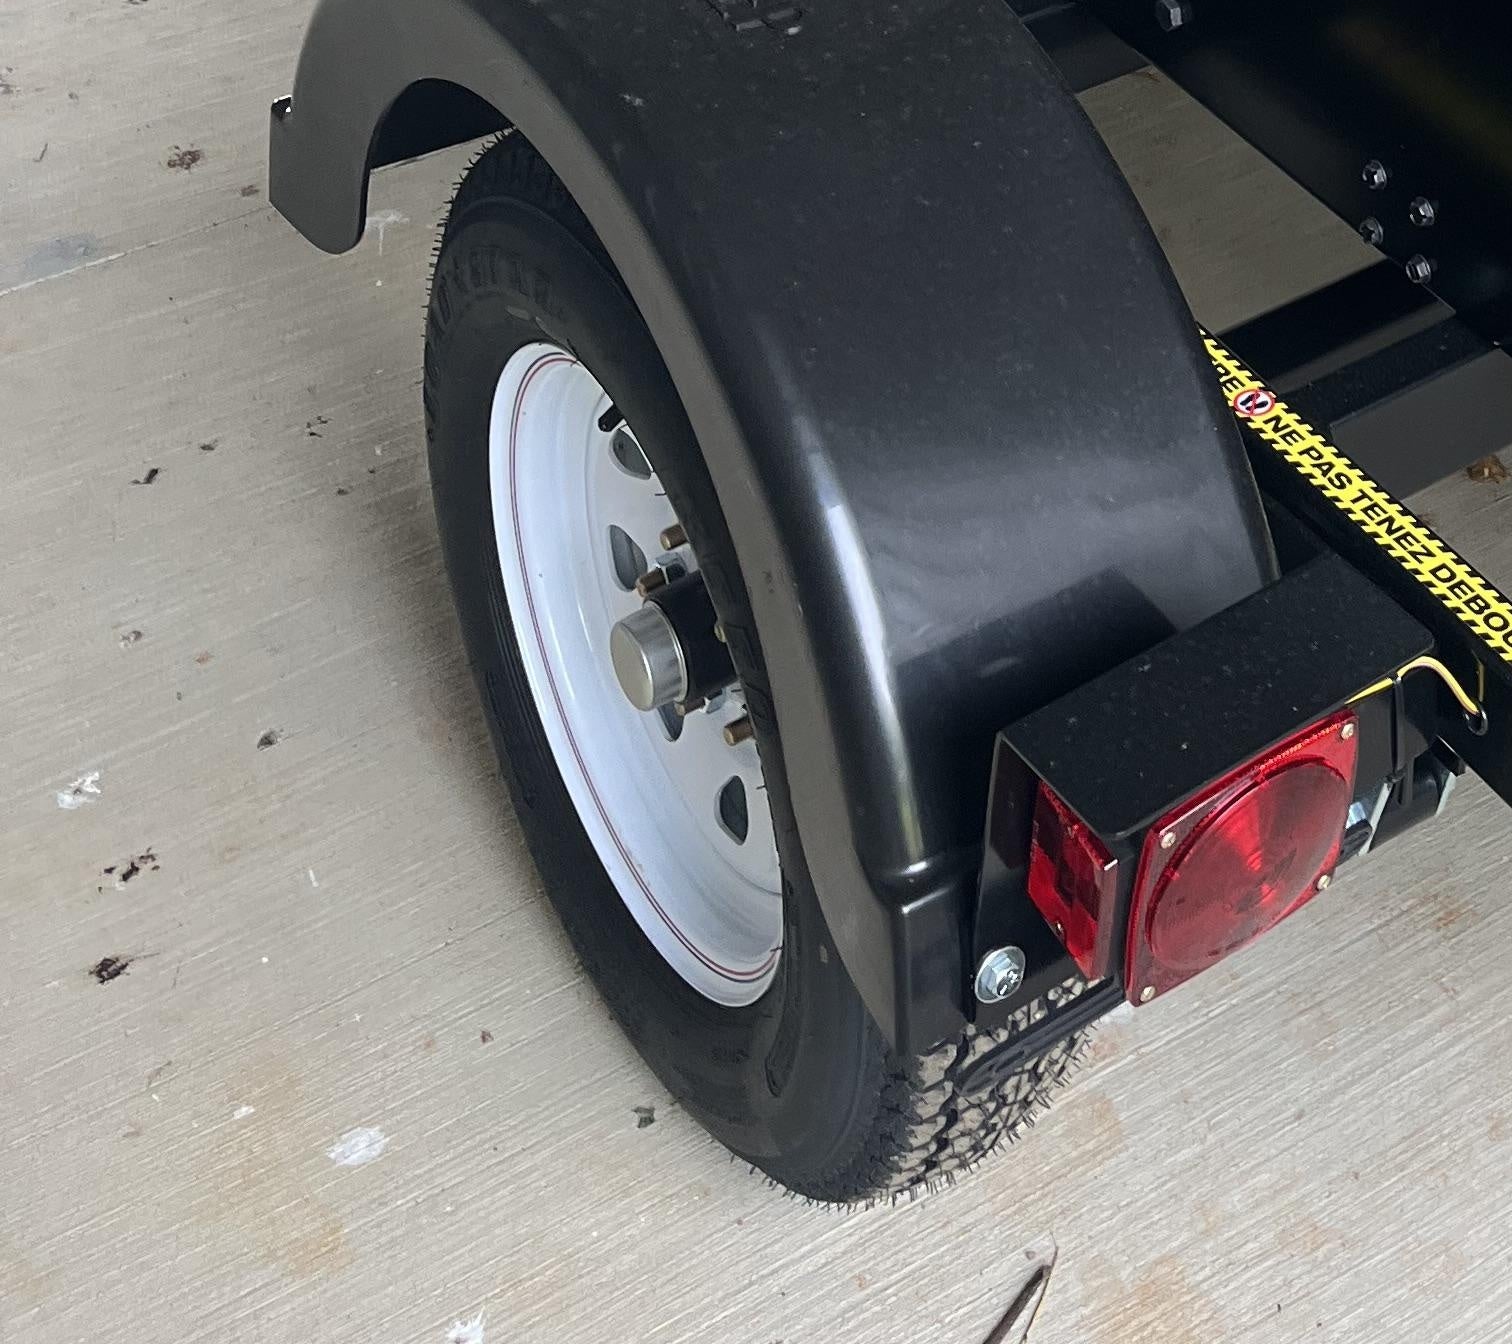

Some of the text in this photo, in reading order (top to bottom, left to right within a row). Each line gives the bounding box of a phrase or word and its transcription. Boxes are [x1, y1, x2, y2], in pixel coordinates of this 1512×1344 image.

[1266, 413, 1301, 447] NE
[1297, 437, 1353, 490] PAS
[1348, 490, 1437, 565] TENEZ
